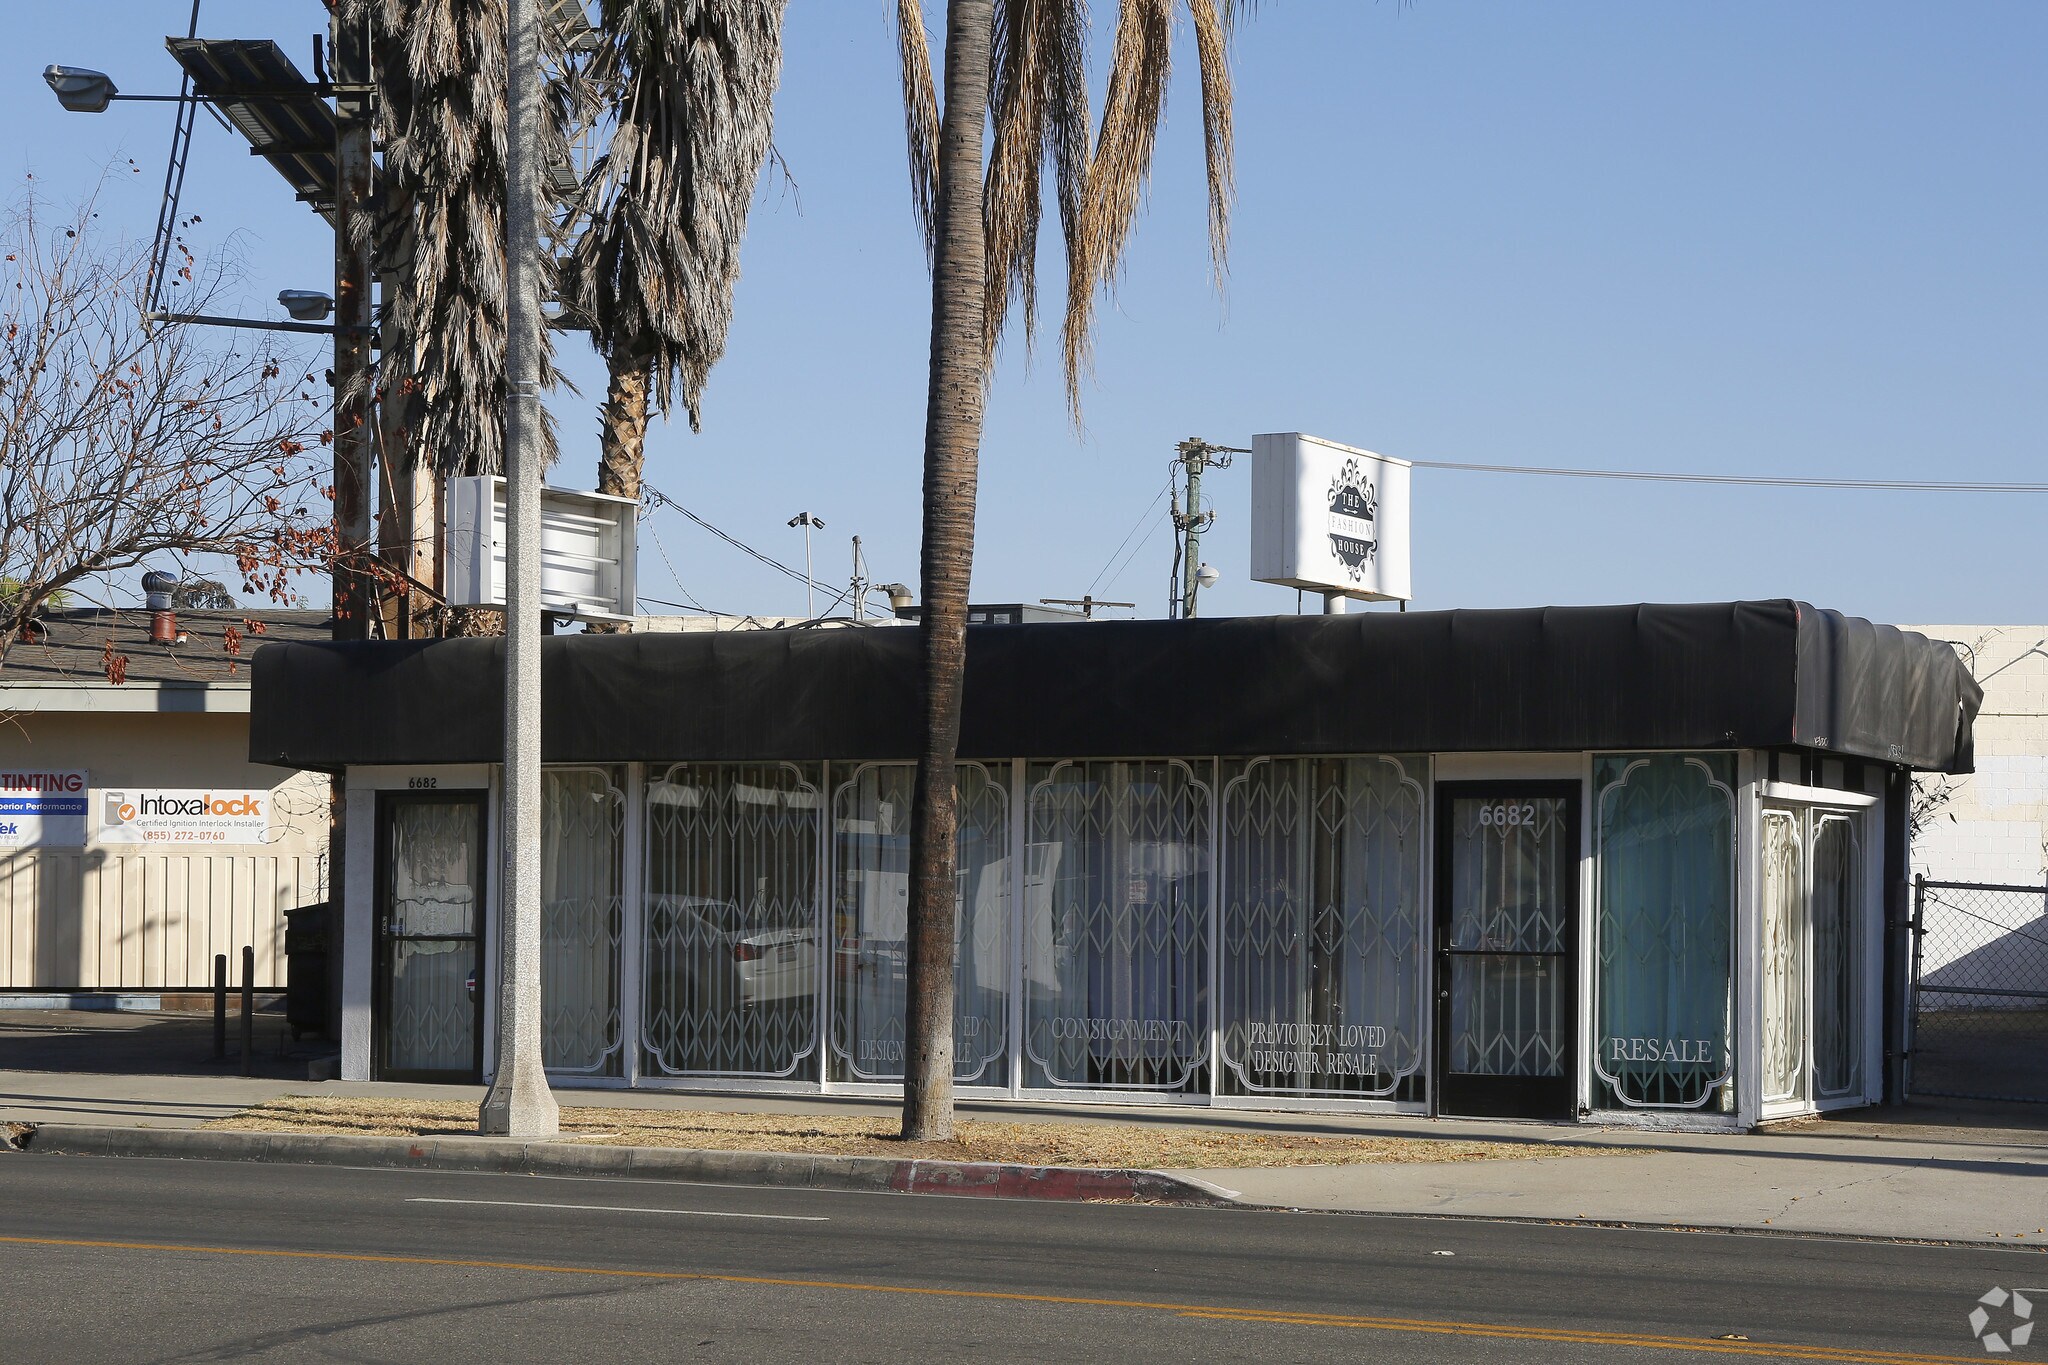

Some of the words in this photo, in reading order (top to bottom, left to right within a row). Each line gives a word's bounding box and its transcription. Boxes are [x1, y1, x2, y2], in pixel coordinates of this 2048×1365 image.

[1342, 493, 1360, 508] THE
[1332, 515, 1371, 536] FASHION
[1338, 539, 1365, 556] HOUSE
[2, 774, 83, 792] TINTING
[408, 777, 437, 788] 6682
[26, 802, 82, 811] Performance
[140, 794, 260, 815] Intoxalock
[136, 819, 168, 827] Certified
[170, 820, 198, 829] Ignition
[200, 820, 232, 828] Interlock
[234, 820, 265, 828] Installer
[1480, 805, 1535, 826] 6682
[143, 831, 171, 841] (855)
[175, 831, 225, 841] 272-0760
[1051, 1017, 1185, 1042] CONSIGNMENT
[1250, 1022, 1333, 1046] PREVIOUSLY
[1339, 1025, 1386, 1048] LOVED
[860, 1039, 905, 1061] DESIGN
[1611, 1037, 1712, 1063] RESALE
[1254, 1050, 1320, 1074] DESIGNER
[1327, 1052, 1377, 1076] RESALE
